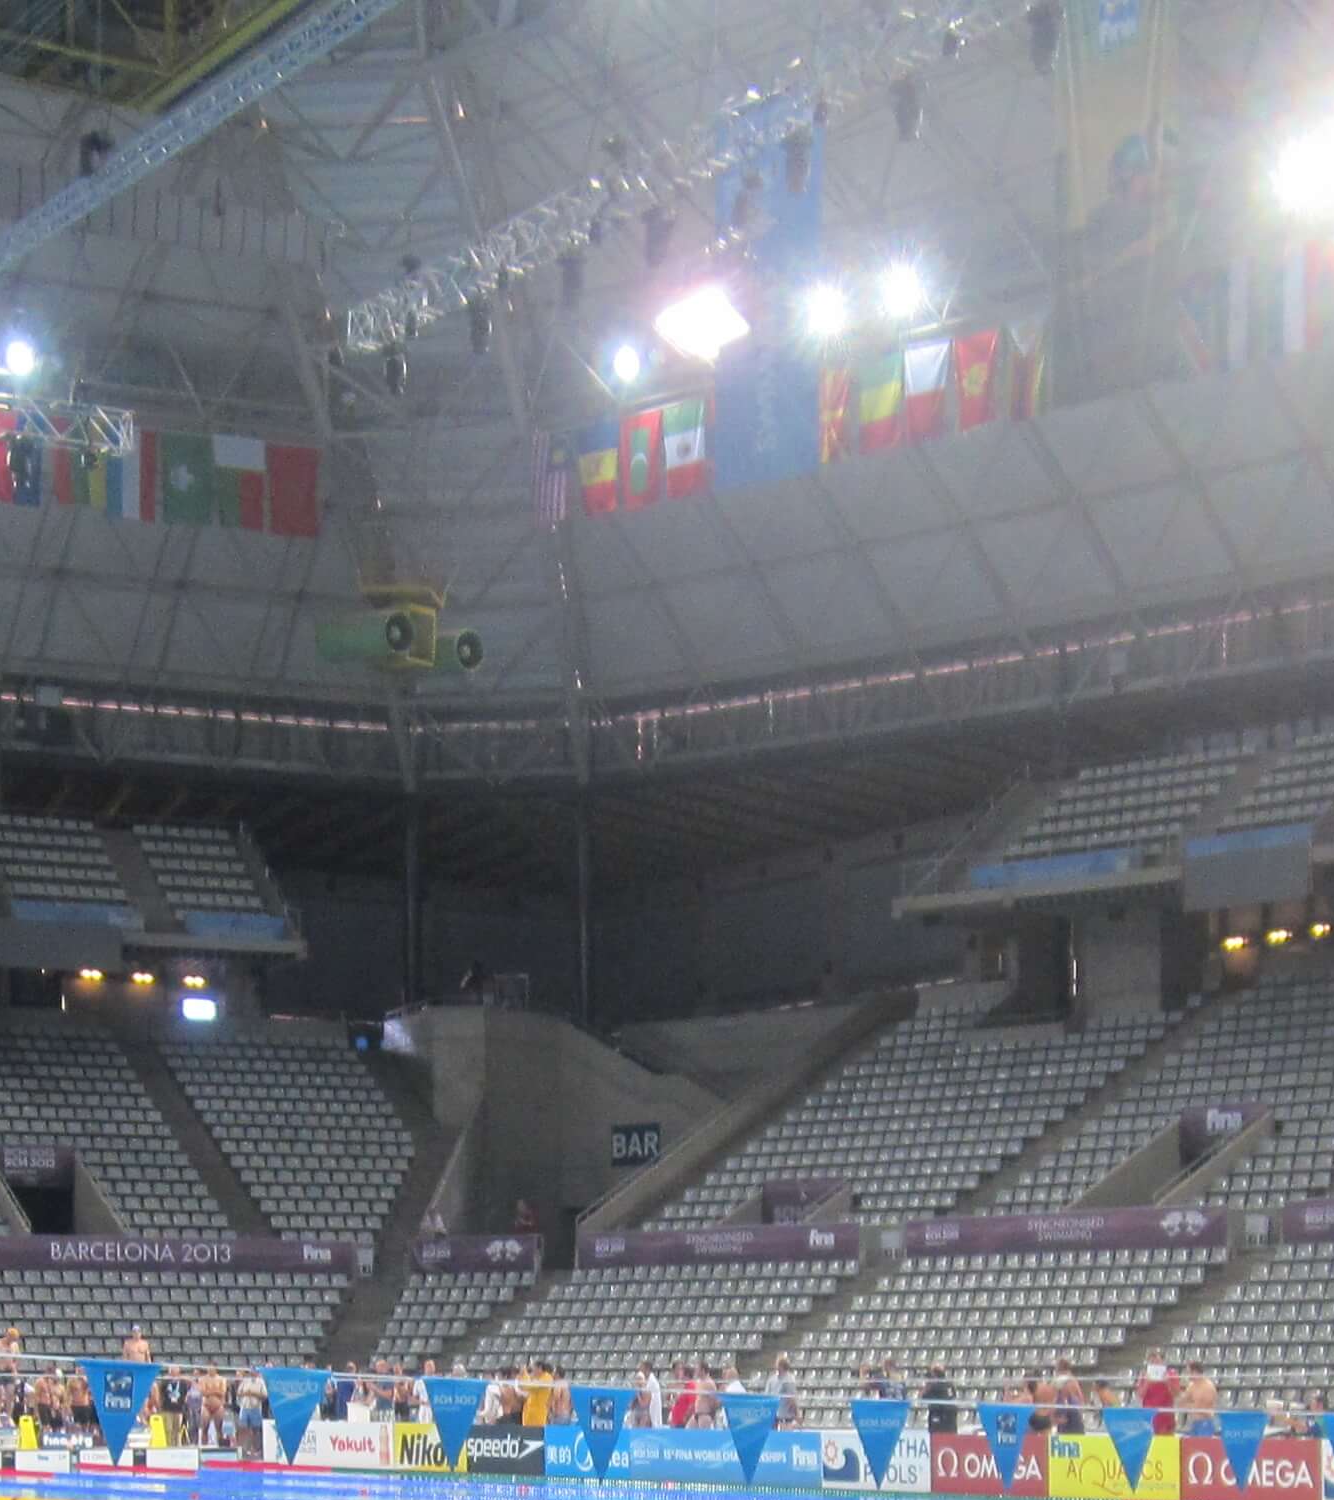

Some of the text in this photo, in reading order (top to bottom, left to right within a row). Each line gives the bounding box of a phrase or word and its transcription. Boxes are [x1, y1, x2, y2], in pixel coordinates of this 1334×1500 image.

[612, 1131, 658, 1158] BAR
[50, 1242, 174, 1261] BARCELONA
[181, 1243, 231, 1263] 2013
[330, 1435, 375, 1453] Yakult
[400, 1434, 447, 1466] Niko
[467, 1434, 519, 1458] speedo
[964, 1456, 1042, 1481] OMGA
